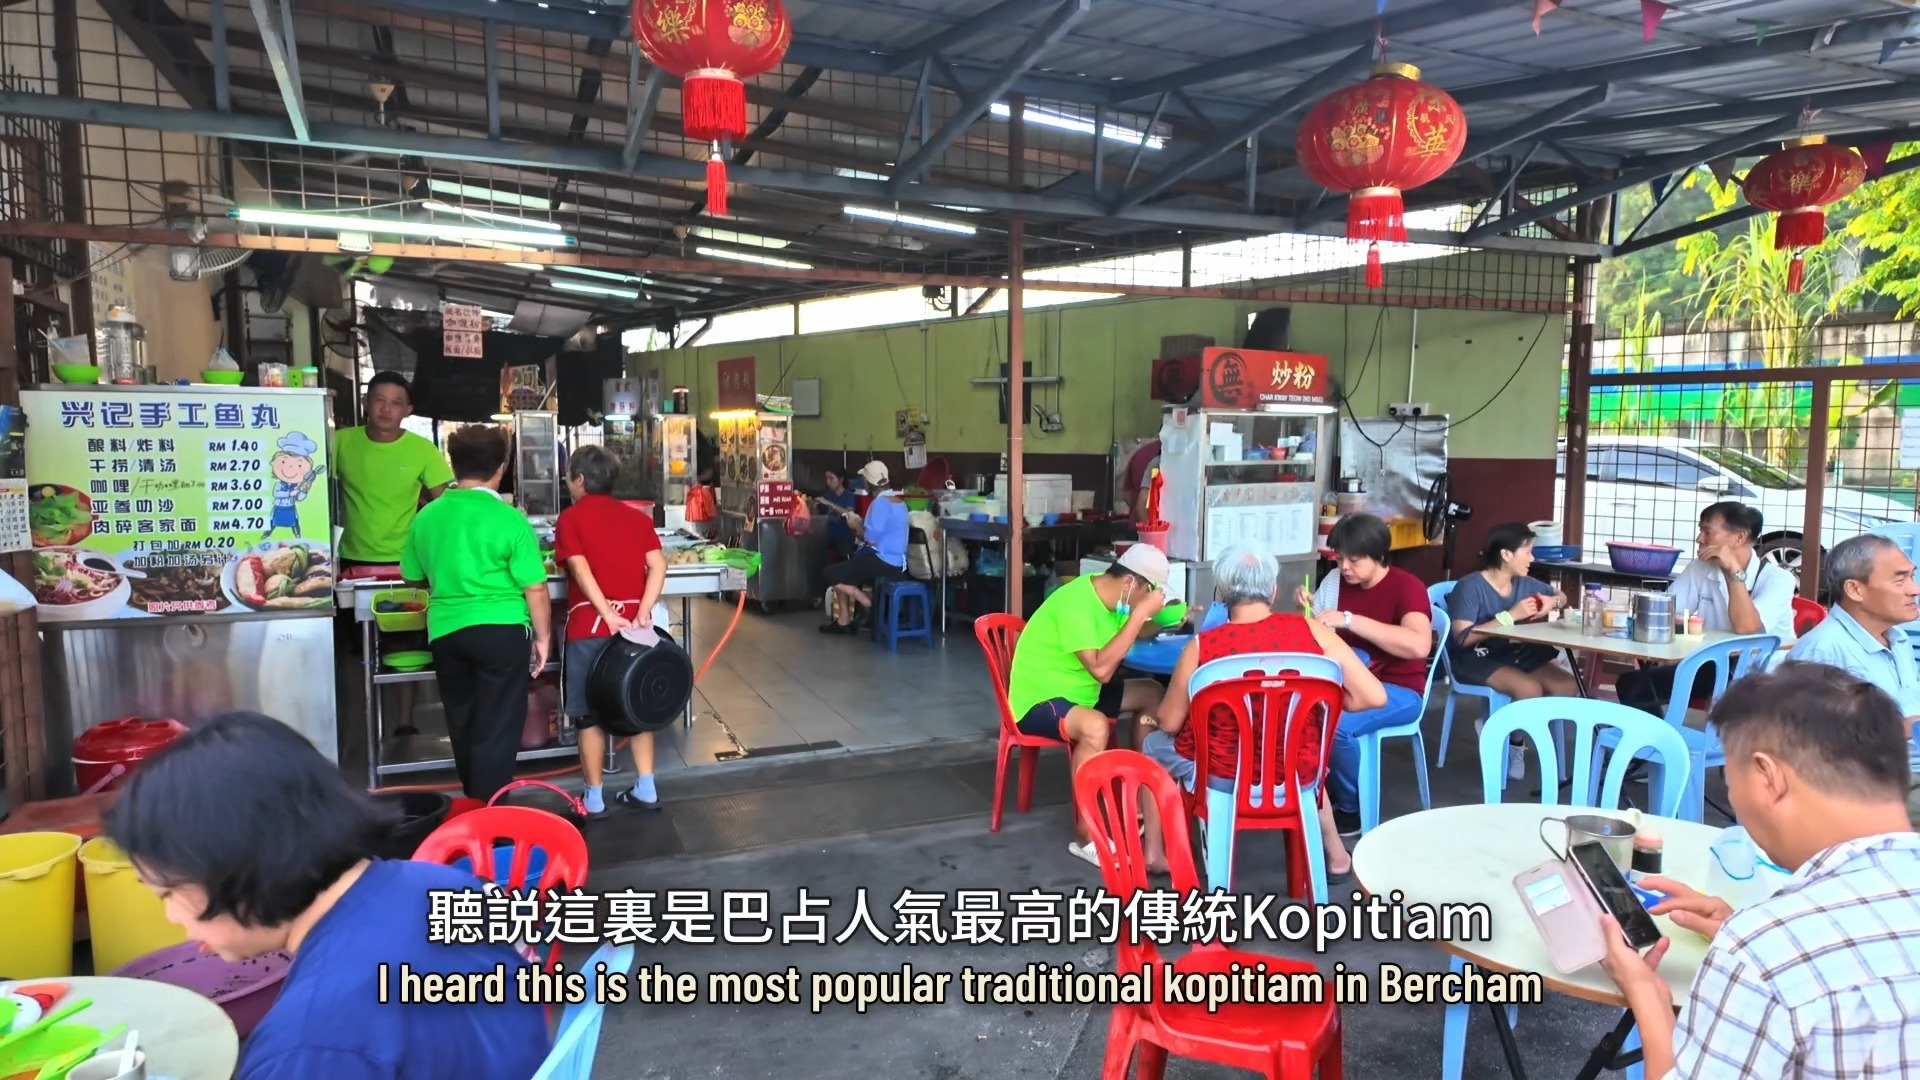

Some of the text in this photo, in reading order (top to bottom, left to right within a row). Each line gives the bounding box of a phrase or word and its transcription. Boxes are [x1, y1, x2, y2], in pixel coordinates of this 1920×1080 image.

[1271, 360, 1315, 390] 炒粉
[62, 401, 280, 428] 兴记手工鱼丸
[209, 439, 258, 452] RM 1.40
[89, 458, 176, 473] 干捞/清汤
[210, 459, 261, 472] RM 2.70
[211, 478, 262, 491] RM 3.60
[212, 498, 263, 511] RM 7.00
[93, 518, 197, 534] 肉碎客家面
[213, 517, 264, 530] RM 4.70
[133, 537, 235, 551] 打包加 RM 0.20
